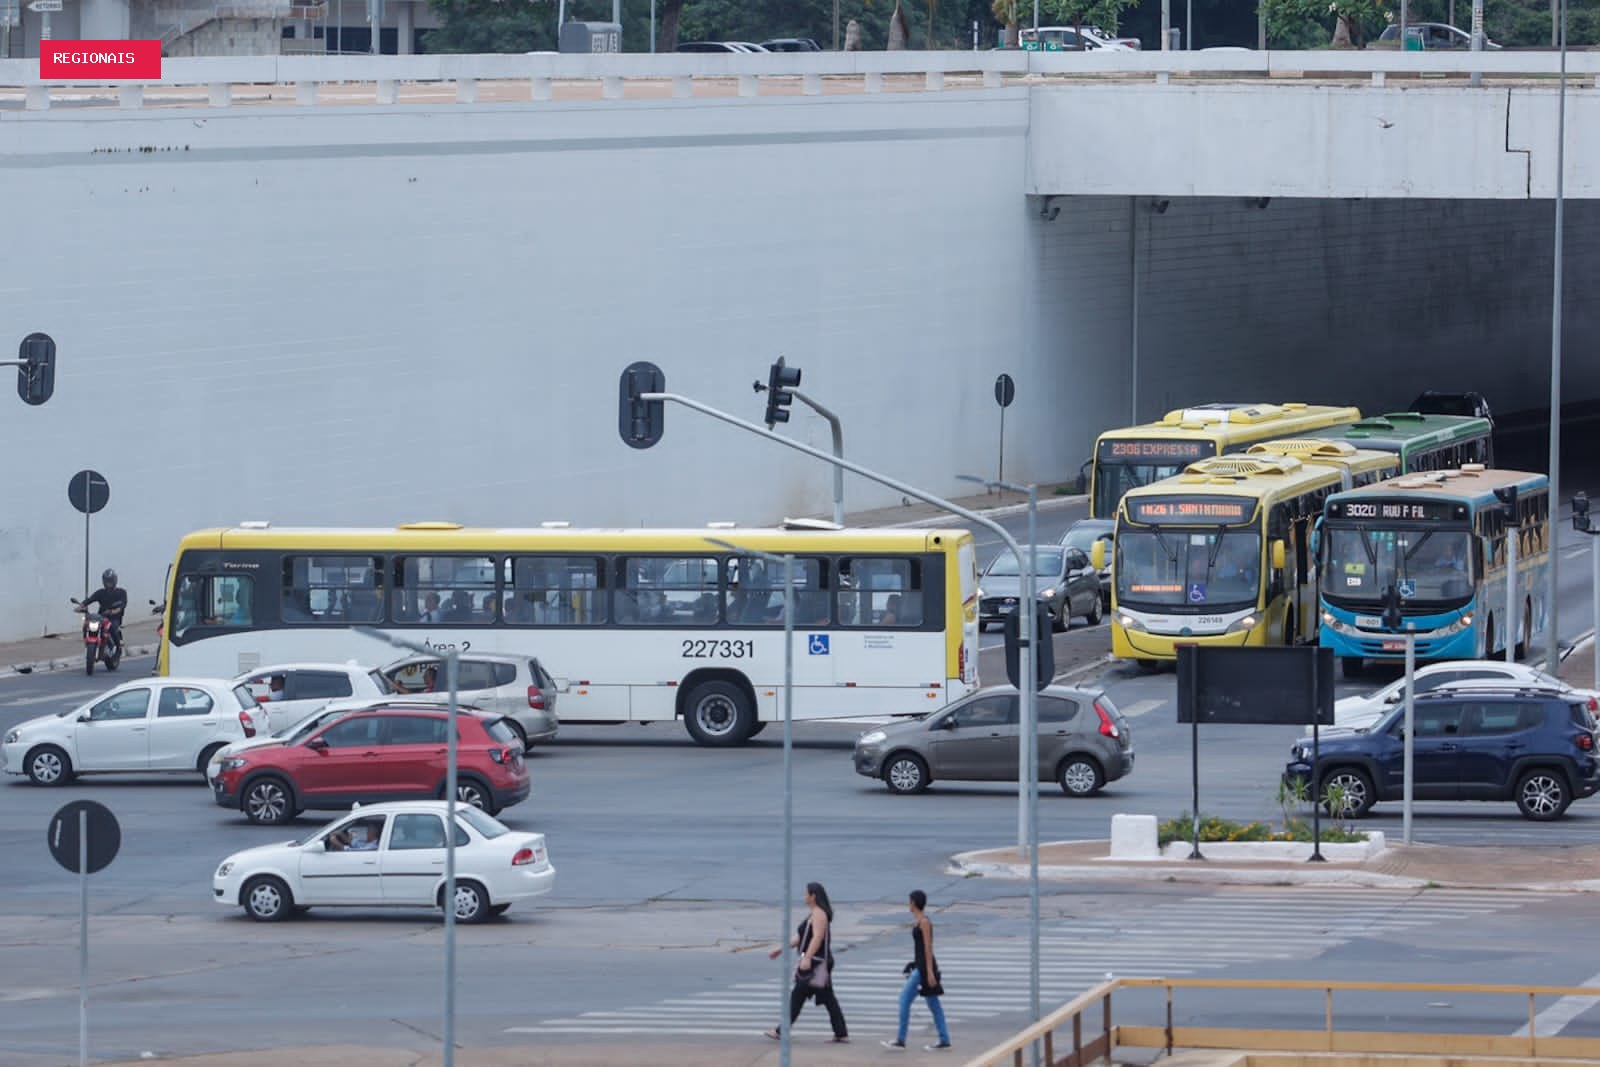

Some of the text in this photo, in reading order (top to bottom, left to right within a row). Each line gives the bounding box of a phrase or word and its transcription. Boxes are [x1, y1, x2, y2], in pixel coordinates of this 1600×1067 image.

[1346, 504, 1376, 516] 3020
[461, 641, 471, 652] 2
[682, 640, 753, 658] 227331
